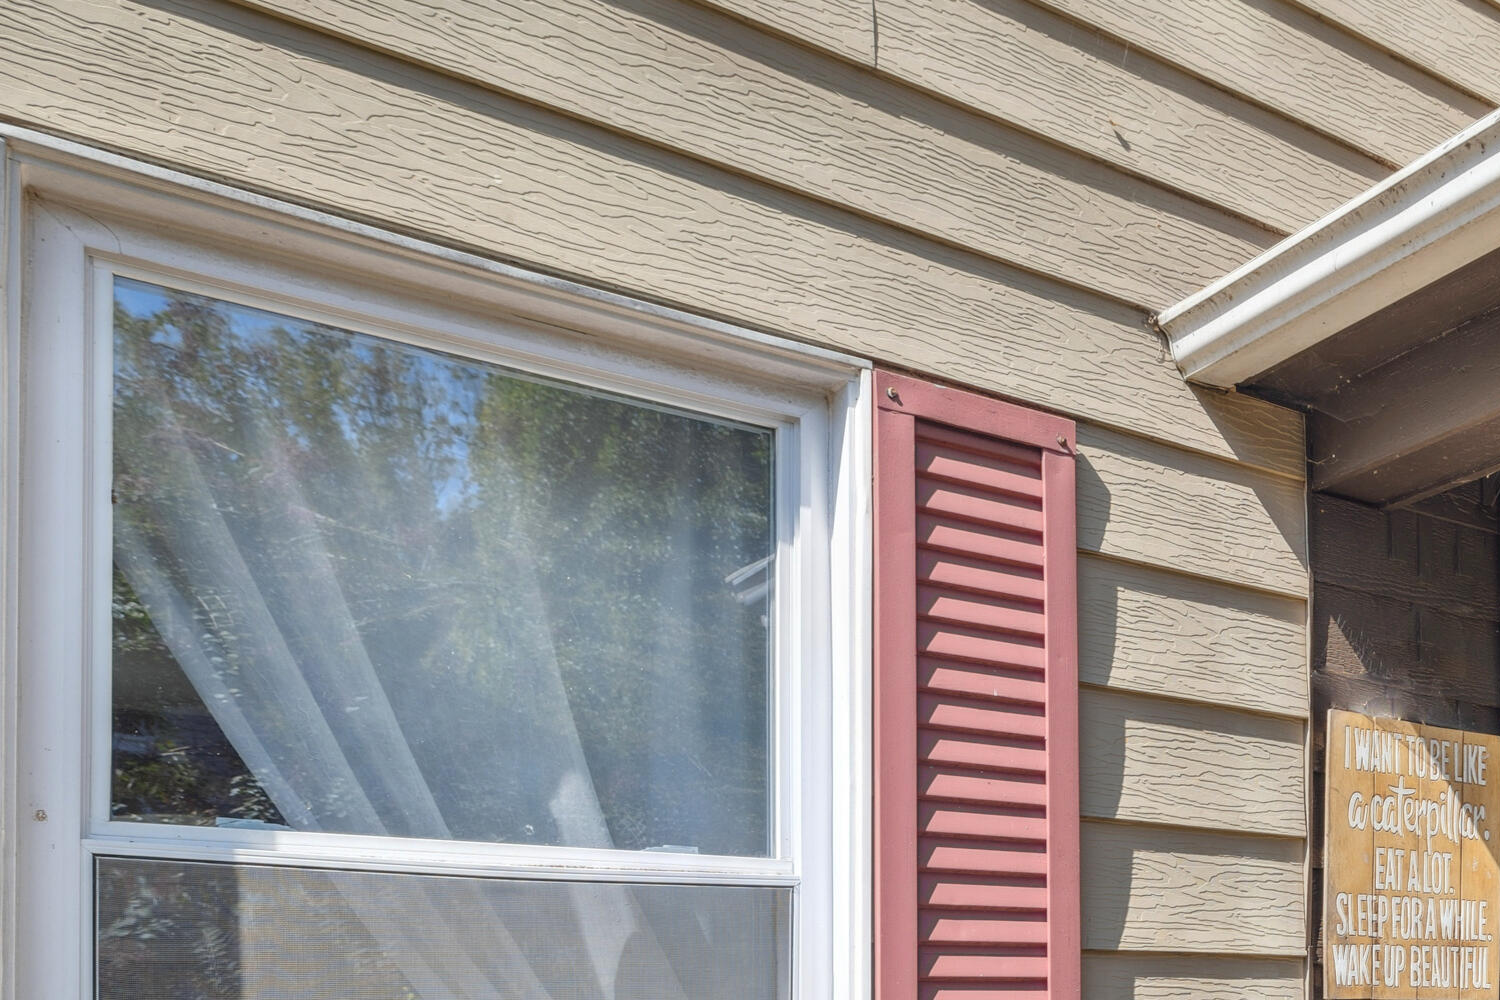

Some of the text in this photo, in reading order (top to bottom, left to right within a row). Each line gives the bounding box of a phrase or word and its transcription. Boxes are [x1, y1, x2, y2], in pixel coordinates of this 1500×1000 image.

[1344, 726, 1487, 786] I WANT TO BE LIKE
[1348, 776, 1490, 854] a caterpillar.
[1375, 848, 1454, 895] EAT A LOT.
[1336, 893, 1492, 942] SLEEP FOR A WHILE.
[1332, 944, 1491, 989] WAKE UP BEAUTIFUL
